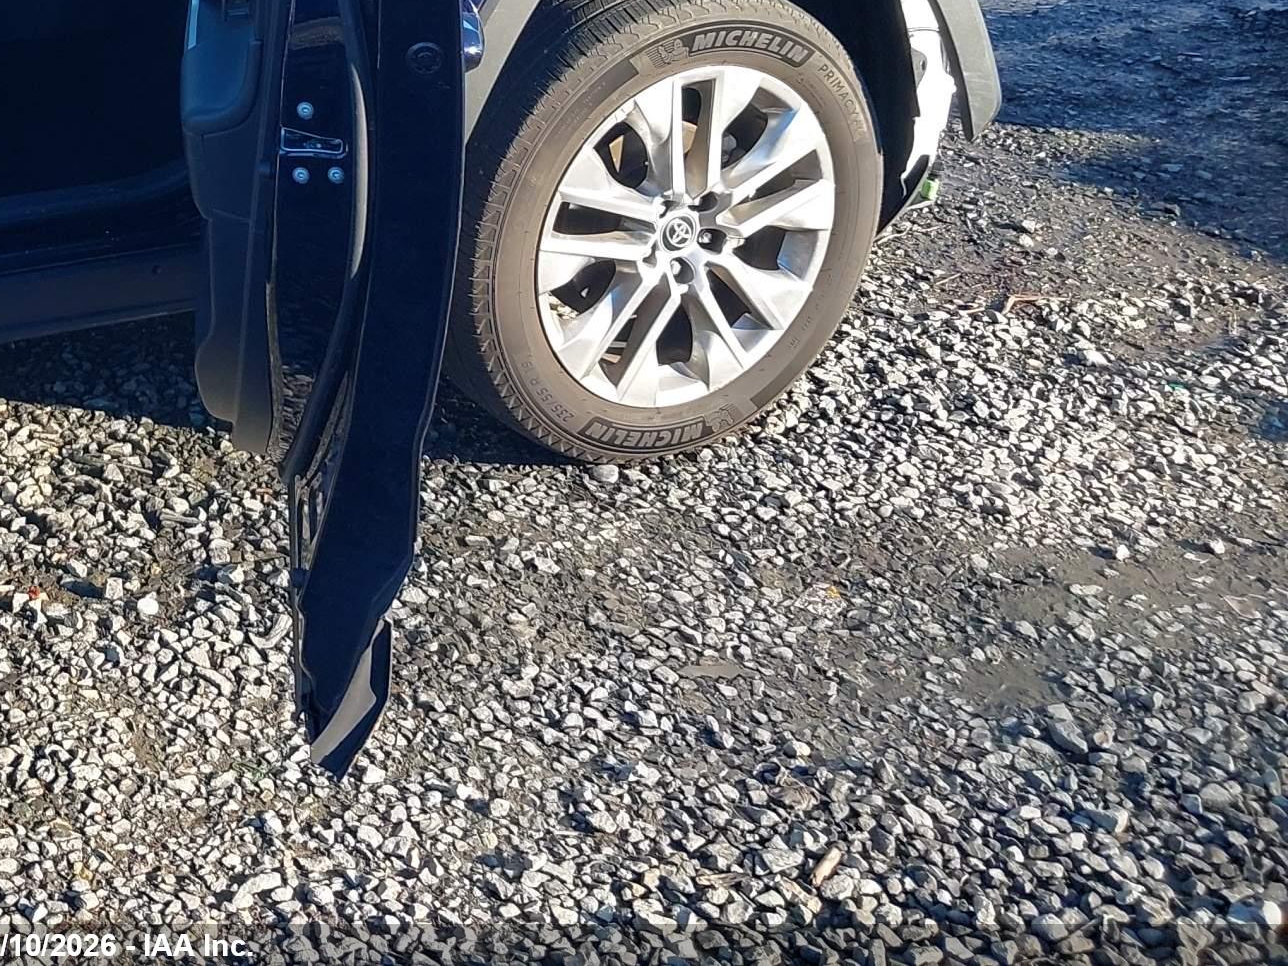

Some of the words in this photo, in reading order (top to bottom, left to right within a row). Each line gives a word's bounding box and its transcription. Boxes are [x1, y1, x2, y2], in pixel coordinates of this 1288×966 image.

[692, 30, 809, 63] MICHELIN
[818, 63, 860, 116] PRIMACY
[536, 387, 577, 423] 235/55
[585, 421, 703, 447] MICHELIN
